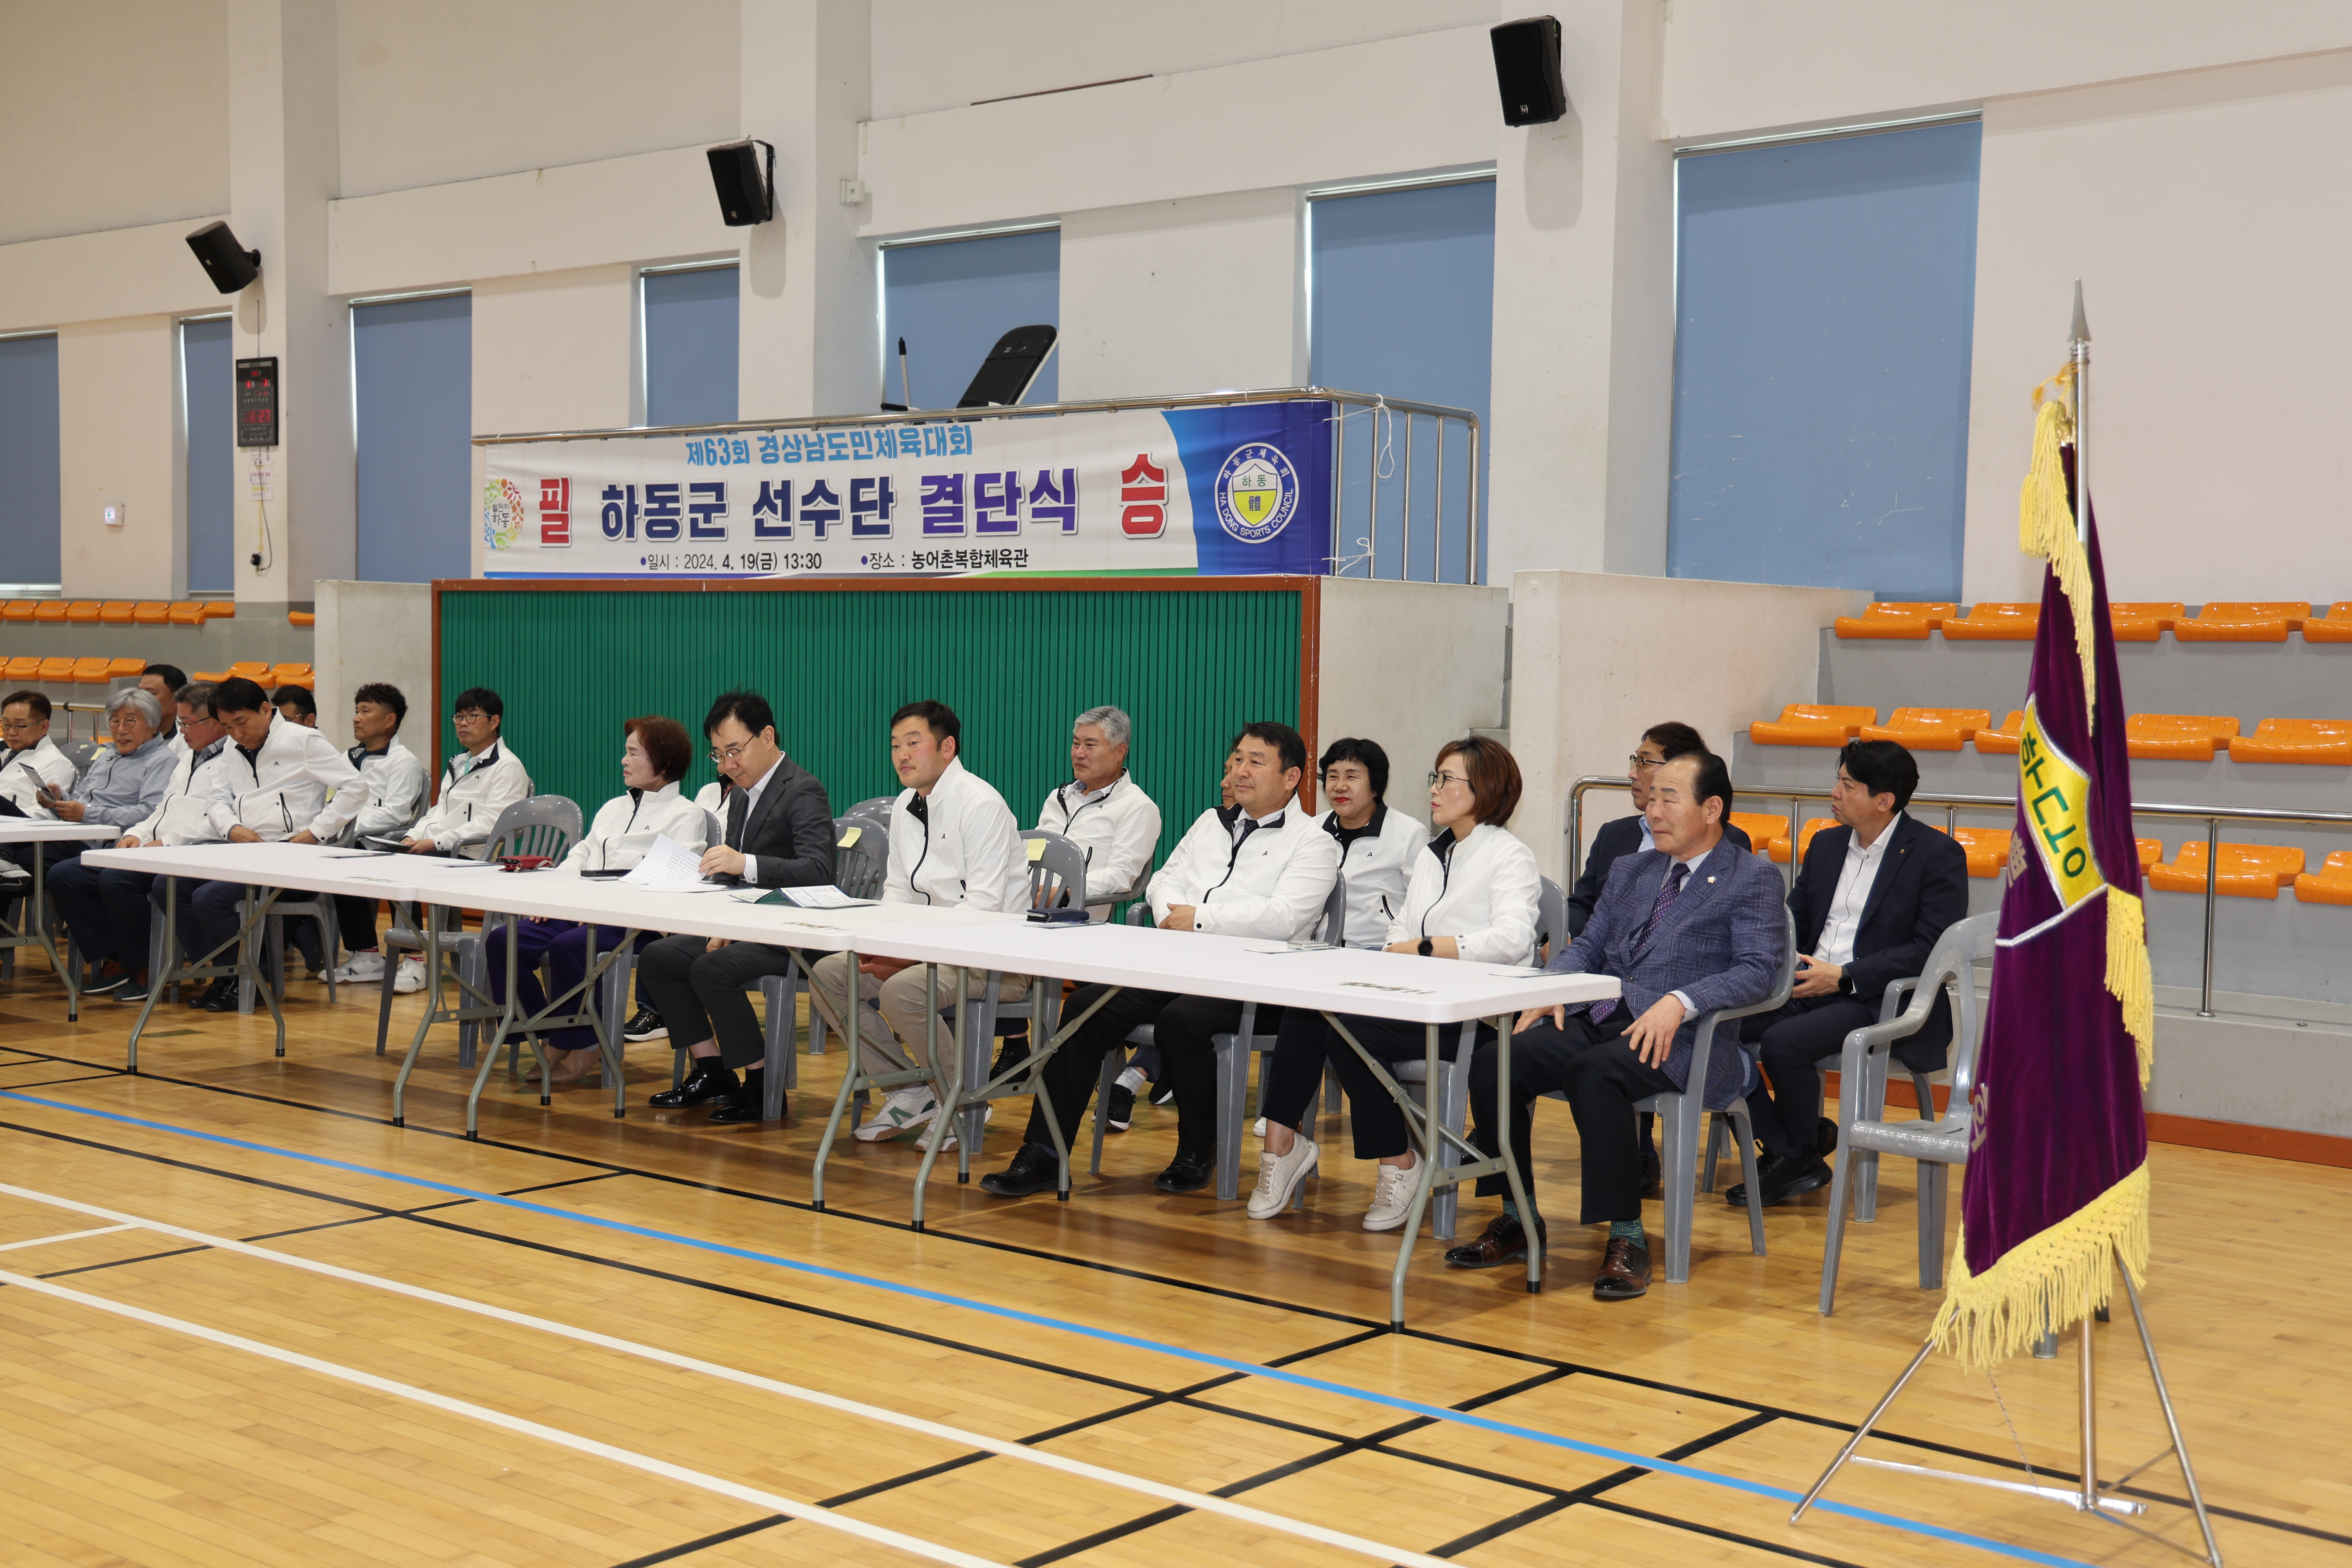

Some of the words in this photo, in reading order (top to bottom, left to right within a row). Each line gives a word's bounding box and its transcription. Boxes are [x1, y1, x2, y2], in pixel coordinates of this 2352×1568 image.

[686, 438, 750, 466] 제63회
[758, 425, 972, 464] 경상남도민체육대회
[1223, 448, 1290, 479] 하동군체육회
[539, 477, 569, 543] 필
[603, 483, 726, 538] 하동군
[753, 477, 893, 536] 선수단
[921, 468, 1075, 534] 결단식
[1122, 454, 1166, 534] 승
[1219, 492, 1227, 507] HA
[1271, 488, 1293, 528] COUNCIL
[492, 513, 509, 528] 하동
[1222, 508, 1239, 532] DONG
[1240, 525, 1271, 537] SPORTS
[648, 554, 669, 570] 일시
[684, 554, 717, 570] 2024.
[722, 554, 733, 570] 4.
[740, 552, 777, 571] 19(금)
[784, 553, 822, 569] 13:30
[870, 552, 895, 570] 장소
[911, 548, 1029, 570] 농어촌복합체육관
